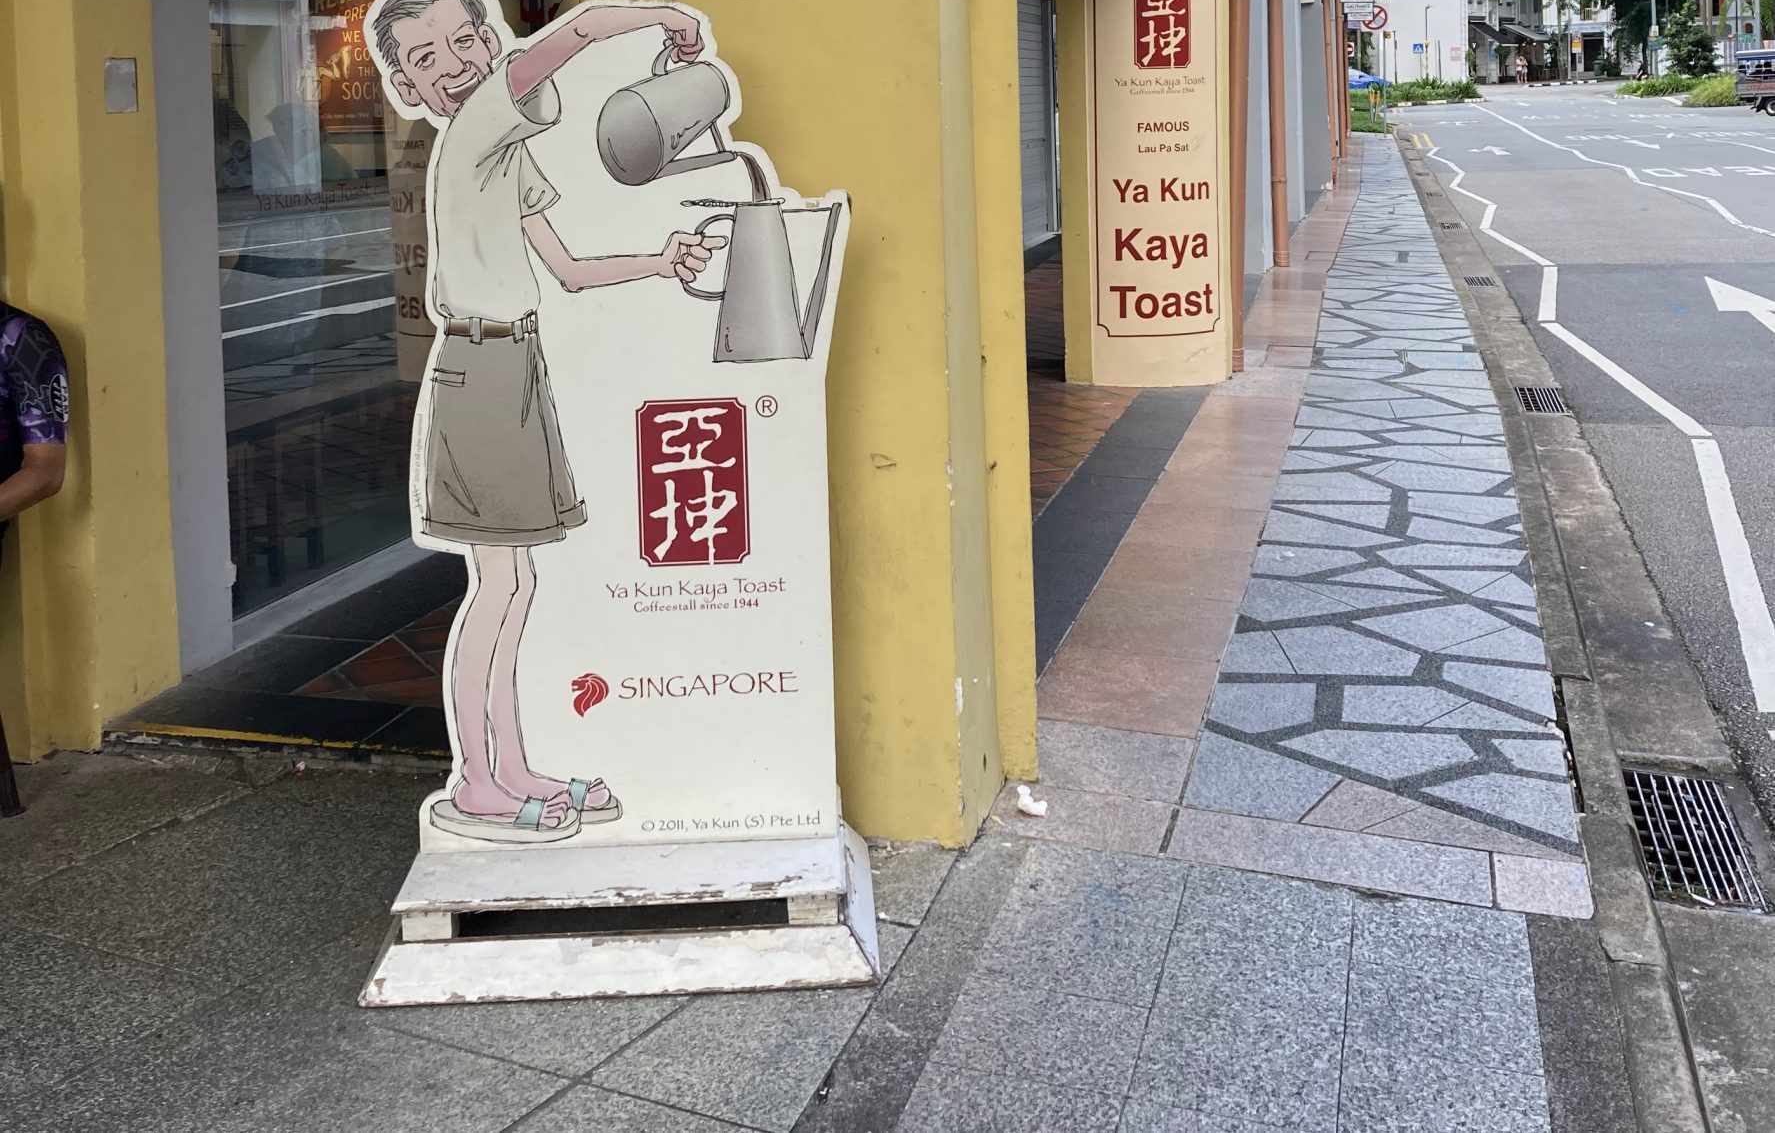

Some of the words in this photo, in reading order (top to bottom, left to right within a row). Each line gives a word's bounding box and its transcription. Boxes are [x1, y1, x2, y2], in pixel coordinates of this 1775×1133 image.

[354, 47, 371, 61] GO
[357, 66, 377, 77] THE
[1114, 77, 1128, 87] Ya
[1130, 78, 1152, 87] Kun
[1155, 77, 1181, 90] Kaya
[1183, 75, 1205, 85] Toast
[1137, 121, 1190, 133] FAMOUS
[1138, 145, 1157, 153] Lau
[1159, 144, 1172, 153] Pa
[1174, 143, 1189, 152] Sat
[1112, 179, 1149, 204] Ya
[1160, 177, 1210, 202] Kun
[1115, 228, 1209, 269] Kaya
[1110, 283, 1213, 319] Toast
[649, 406, 738, 565] 亞坤
[605, 582, 629, 599] Ya
[634, 581, 673, 598] Kun
[678, 579, 728, 603] Kaya
[732, 577, 787, 594] Toast
[633, 600, 697, 613] Coffeestall
[699, 601, 730, 611] since
[733, 598, 760, 609] 1944
[618, 670, 799, 700] SINGAPORE
[658, 819, 689, 833] 2011,
[692, 818, 708, 830] Ya
[712, 818, 740, 829] Kun
[744, 815, 765, 829] (S)
[770, 816, 793, 827] Pte
[797, 810, 821, 826] Ltd
